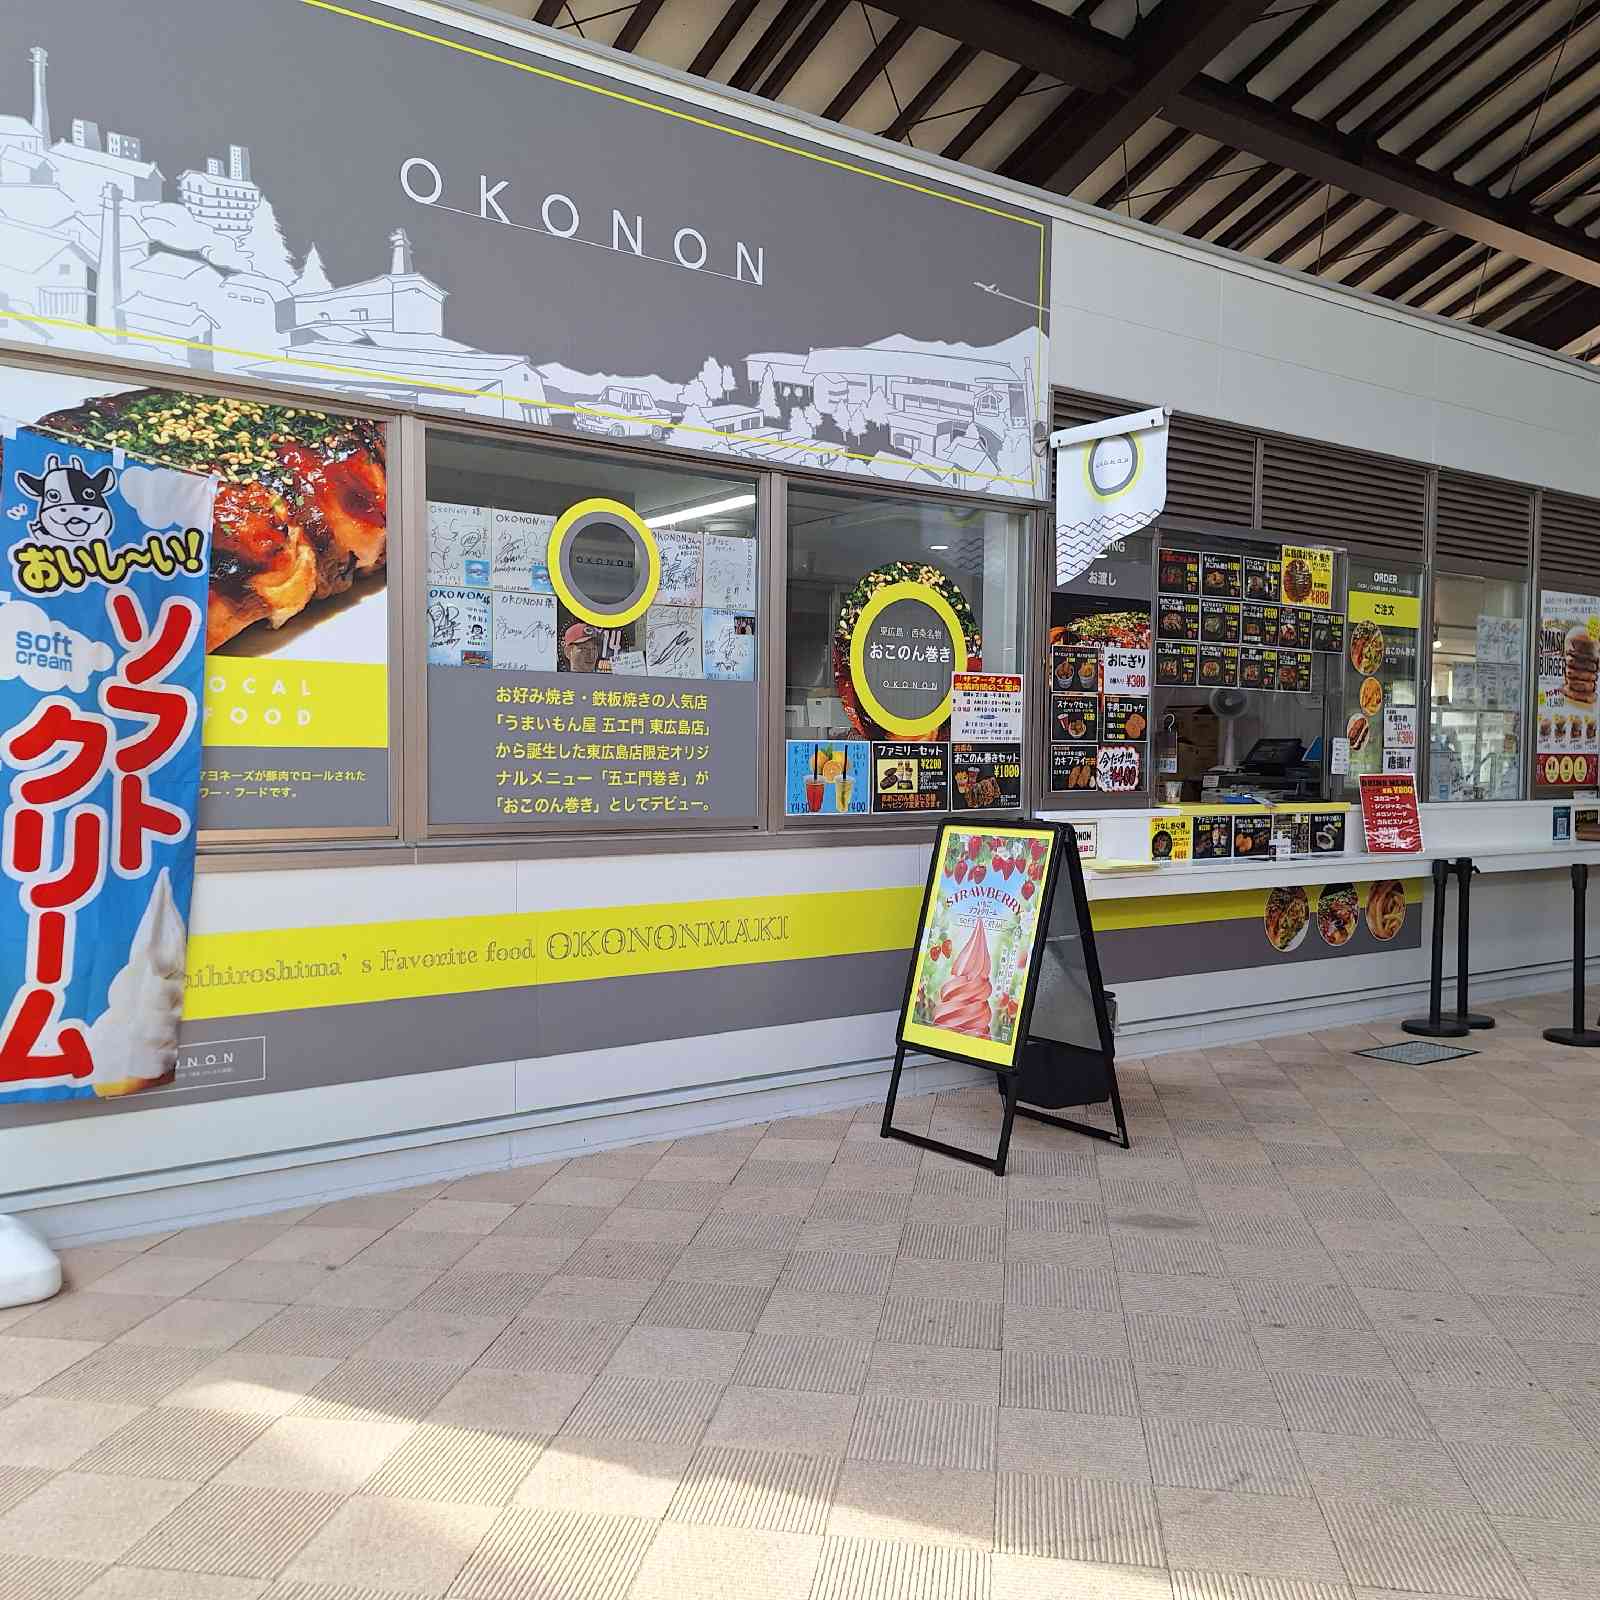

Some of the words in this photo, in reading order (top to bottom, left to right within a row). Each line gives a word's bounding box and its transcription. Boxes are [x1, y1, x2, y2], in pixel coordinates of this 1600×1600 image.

[400, 157, 764, 286] OKONON
[576, 555, 633, 568] OKONON
[1088, 571, 1116, 586] お渡し
[1374, 573, 1398, 584] ORDER
[1374, 603, 1395, 616] ご注文
[16, 631, 72, 657] soft
[1539, 630, 1566, 655] SMASH
[16, 651, 72, 672] cream
[870, 642, 950, 664] おこのん巻き
[1107, 653, 1146, 668] おにぎり
[1538, 656, 1567, 677] BURGER
[208, 676, 311, 696] OCAL
[883, 680, 938, 690] OKONON
[496, 687, 708, 711] お好み焼き・鉄板焼きの人気店
[1057, 700, 1093, 709] スナックセット
[1107, 703, 1145, 713] 牛肉コロッケ
[106, 594, 192, 871] ソフト
[649, 718, 711, 736] 東広島店」
[496, 742, 710, 761] から誕生した東広島店限定オリジ
[878, 745, 943, 756] ファミリーセット
[954, 753, 1019, 763] おこのん巻きセット
[1054, 756, 1086, 766] カキフライ
[994, 765, 1019, 778] ¥1000
[496, 797, 711, 815] 「おこのん巻き」としてデビュー。
[0, 704, 107, 1078] クリーム
[944, 885, 1024, 916] STRAWBERRY
[380, 948, 479, 974] Favorite
[485, 939, 536, 963] food
[546, 914, 791, 961] OKONONMAKI
[176, 1052, 233, 1069] NON
